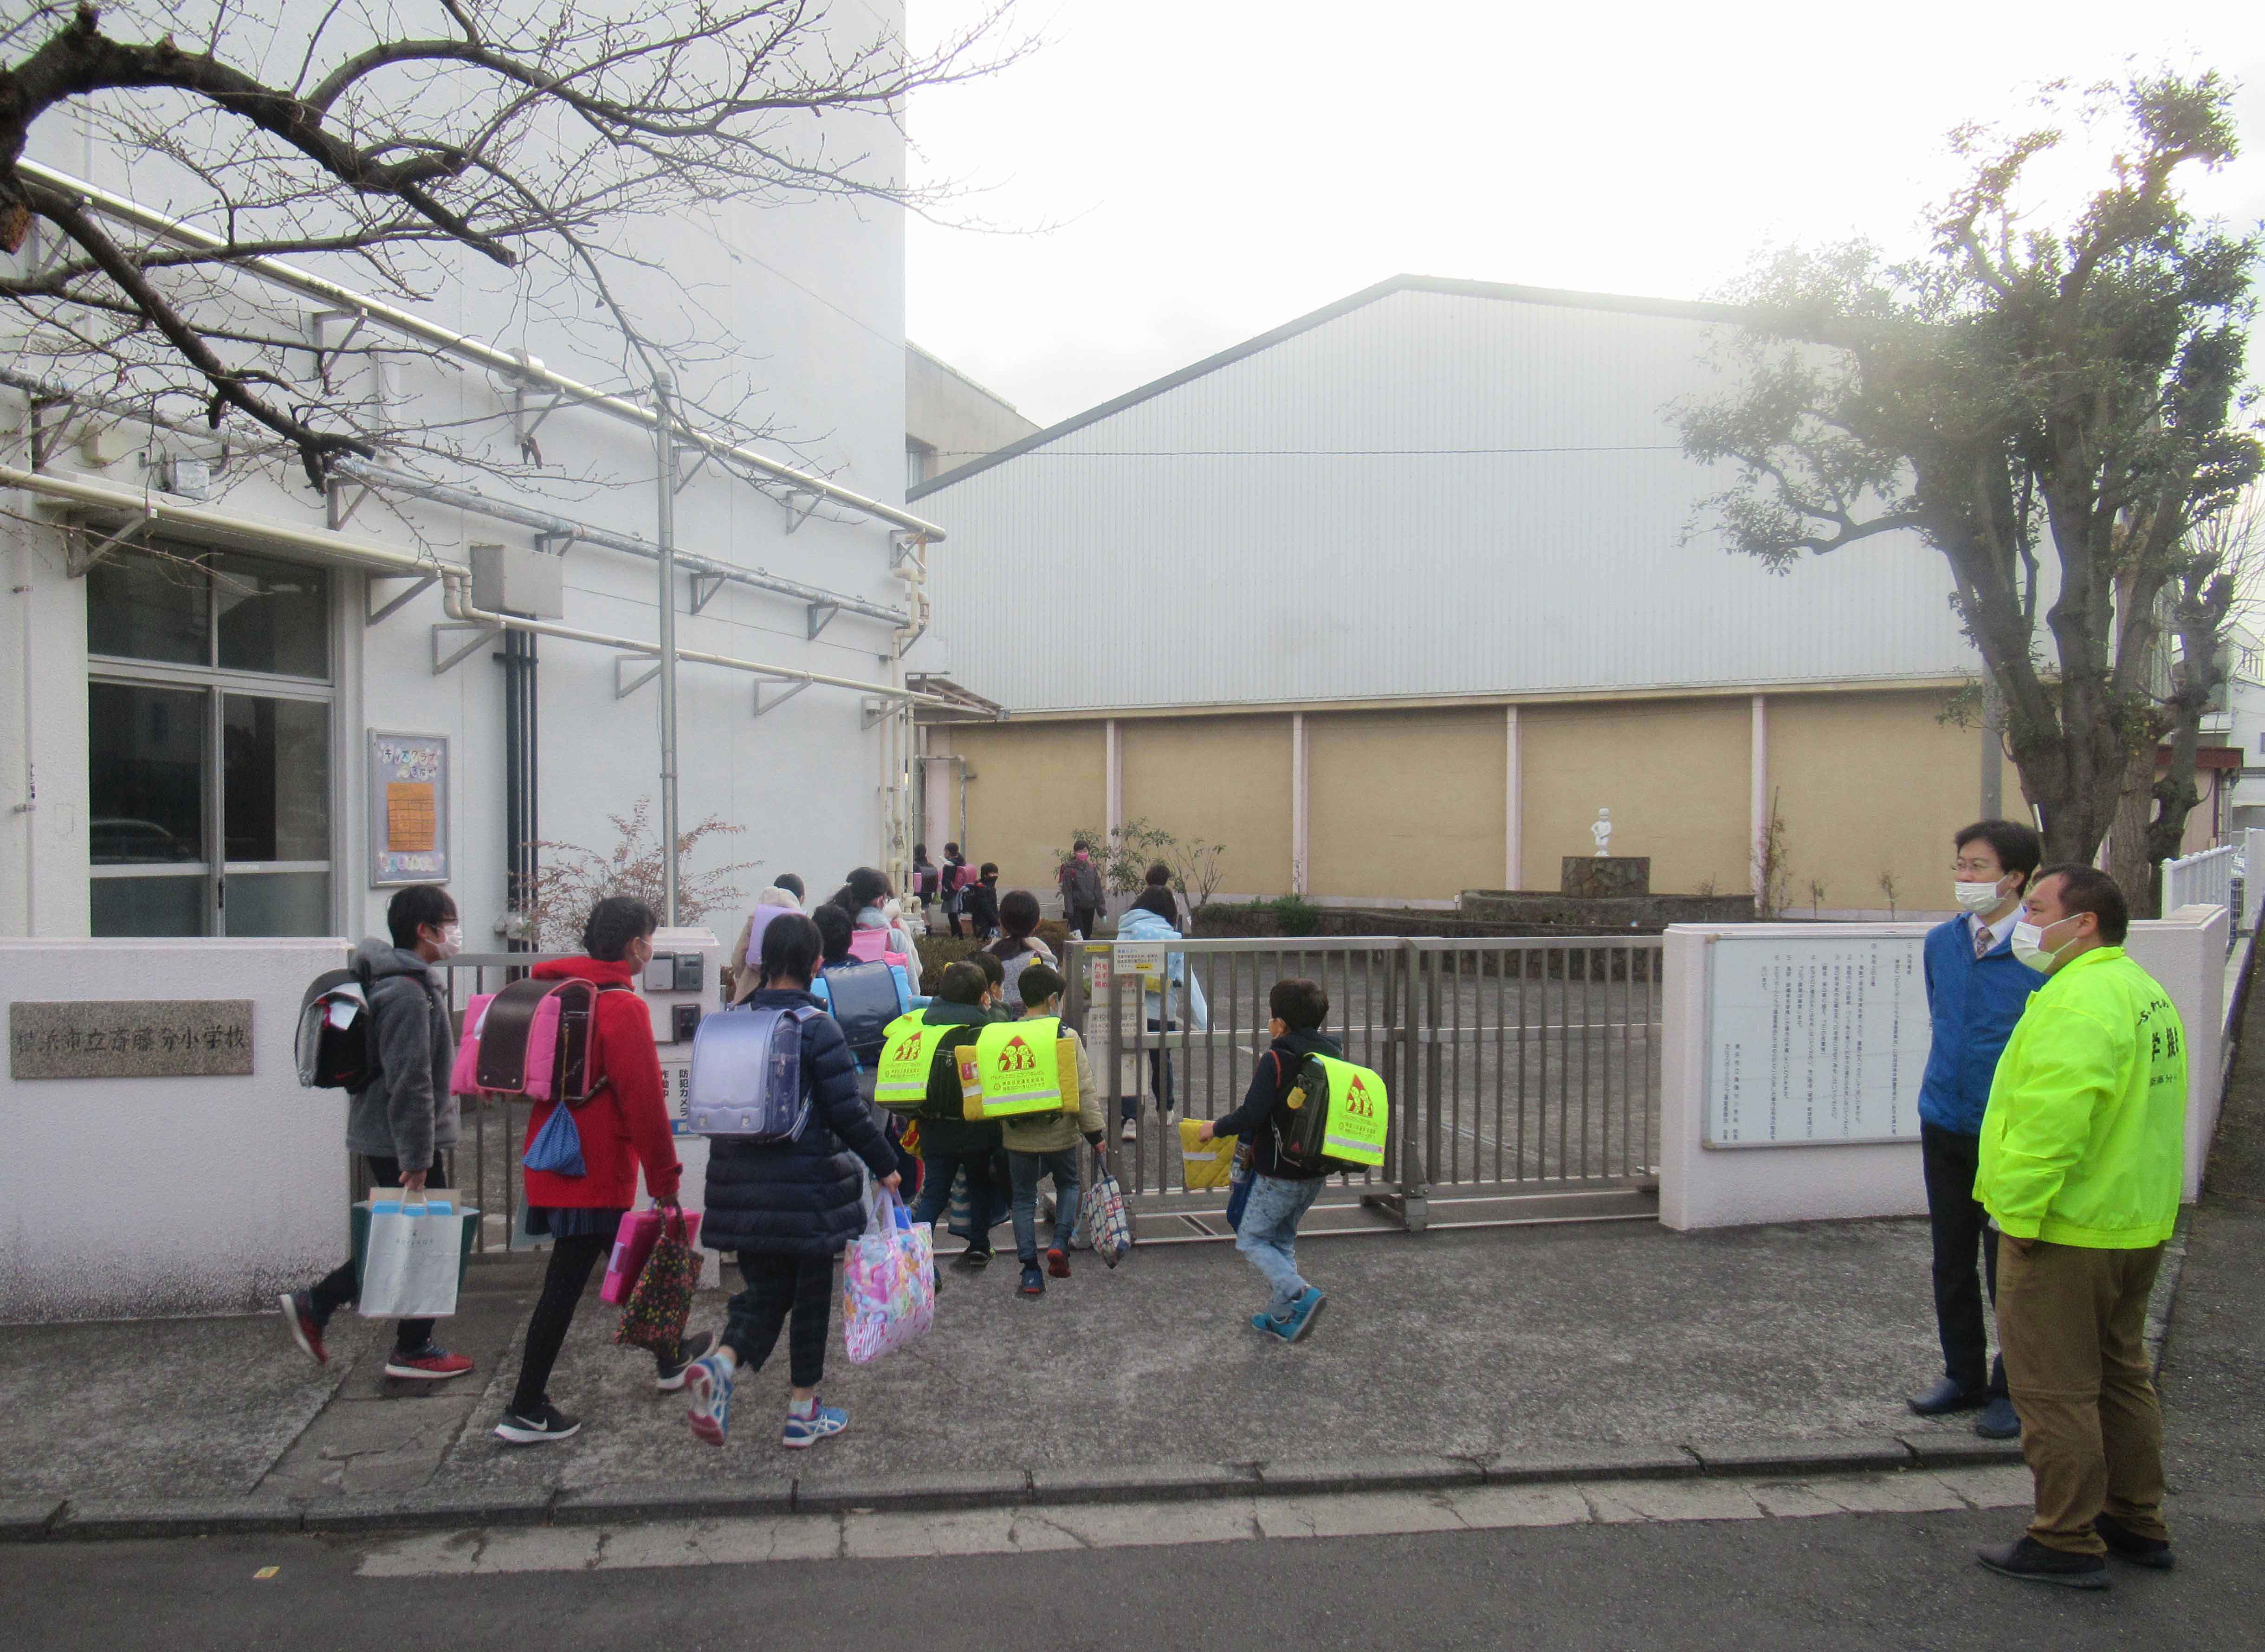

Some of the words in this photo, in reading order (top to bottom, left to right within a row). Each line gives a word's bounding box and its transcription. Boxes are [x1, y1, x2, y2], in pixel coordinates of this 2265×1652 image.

[679, 1069, 688, 1116] 防犯カメラ
